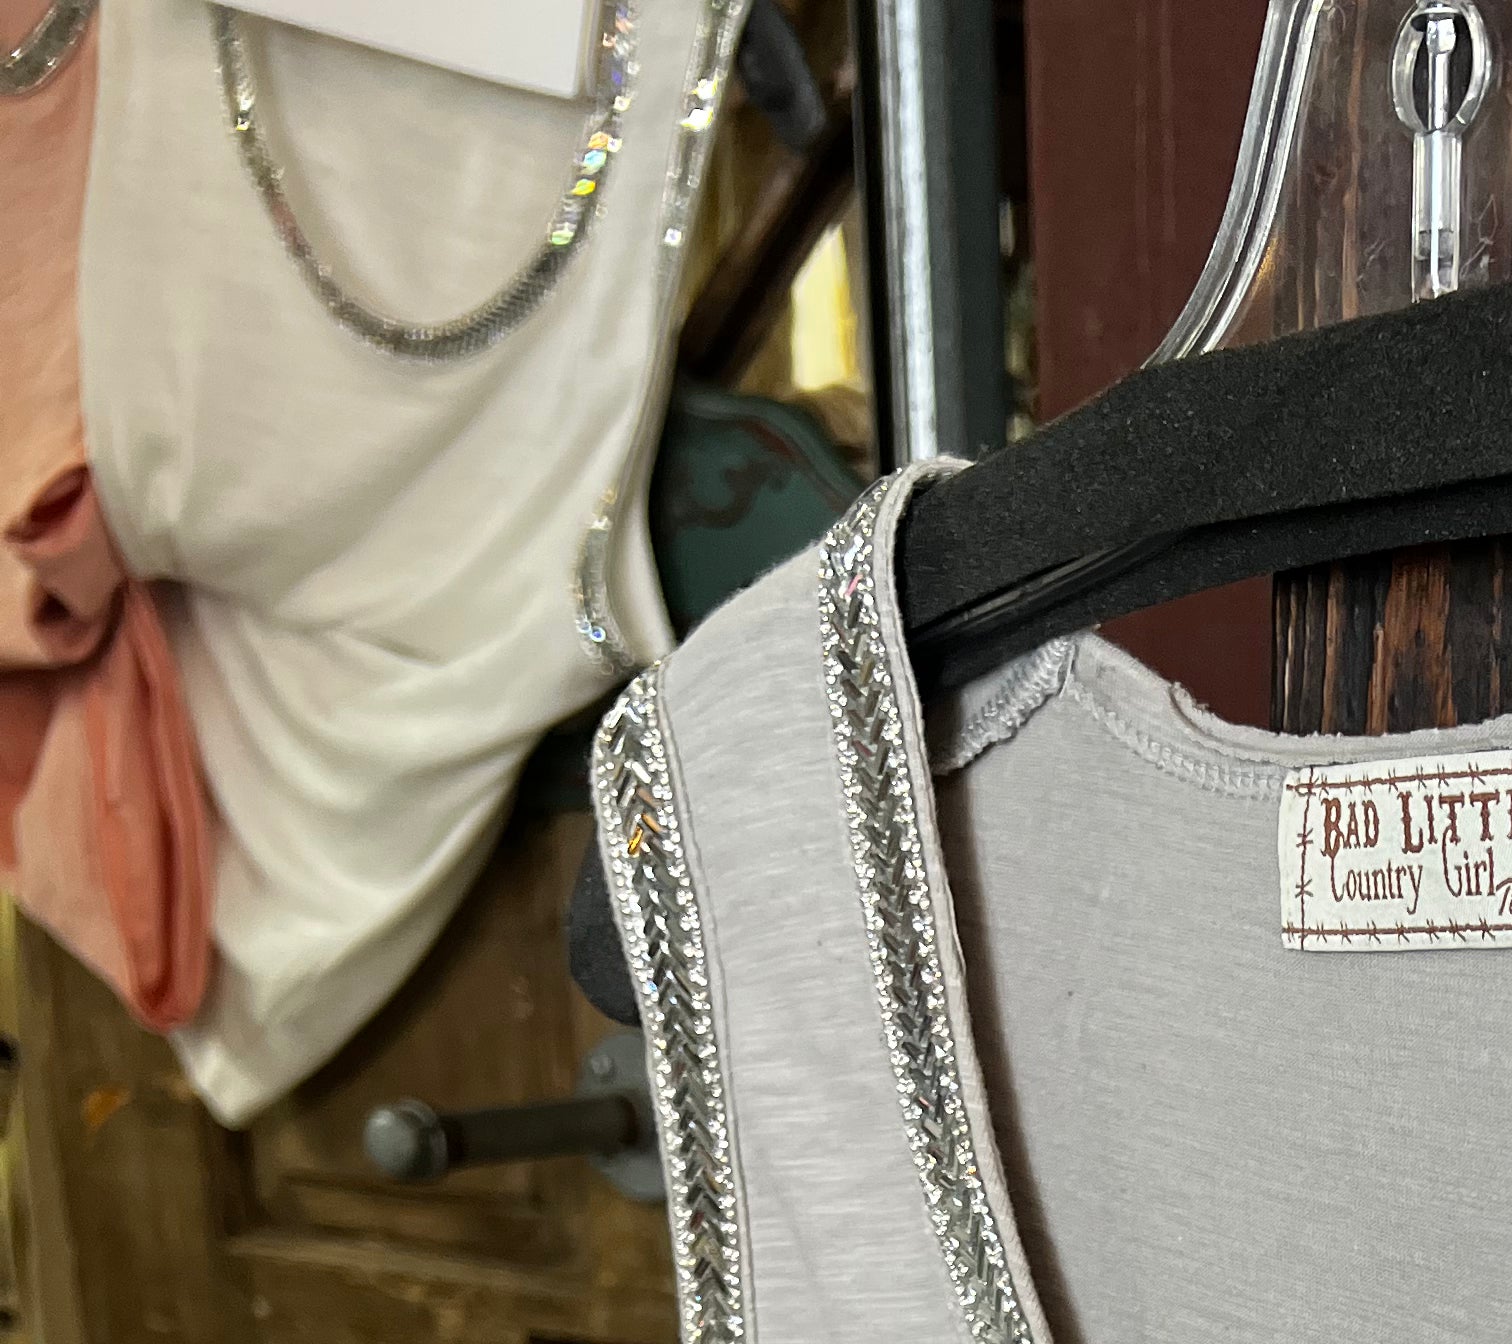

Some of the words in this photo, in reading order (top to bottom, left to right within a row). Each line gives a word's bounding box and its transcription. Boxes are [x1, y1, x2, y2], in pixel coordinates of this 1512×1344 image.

[1320, 797, 1380, 858] BAD
[1330, 848, 1424, 915] Country
[1441, 826, 1496, 898] Girl
